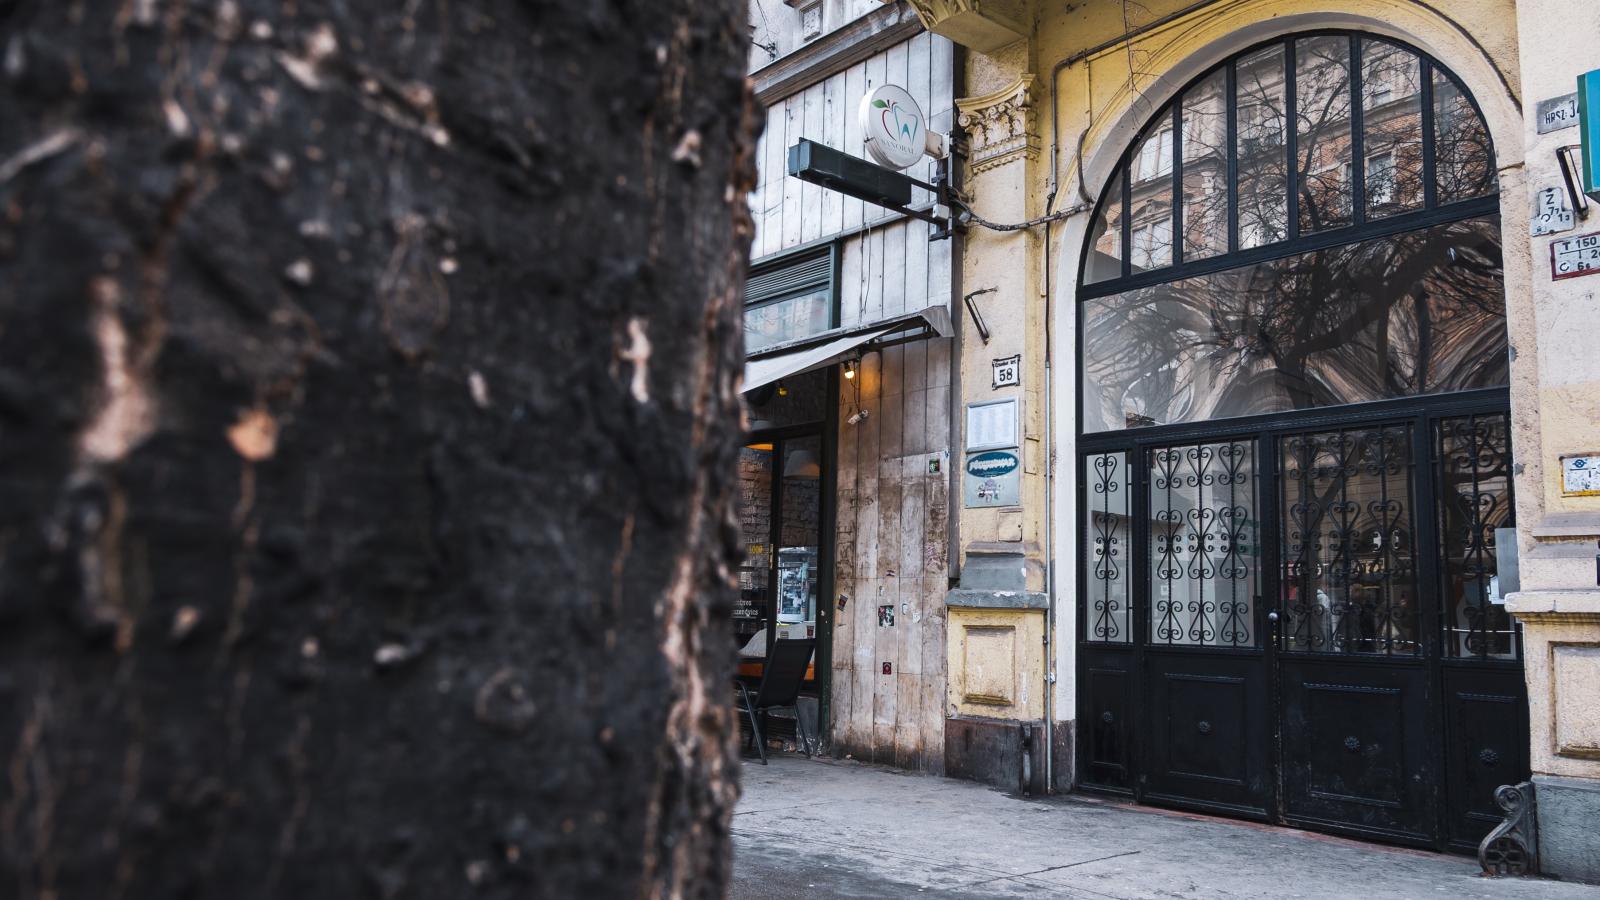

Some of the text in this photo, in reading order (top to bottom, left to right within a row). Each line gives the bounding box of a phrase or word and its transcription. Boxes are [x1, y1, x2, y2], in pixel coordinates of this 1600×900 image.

[1545, 194, 1554, 205] Z
[1562, 236, 1597, 251] T 150
[999, 367, 1013, 382] 58
